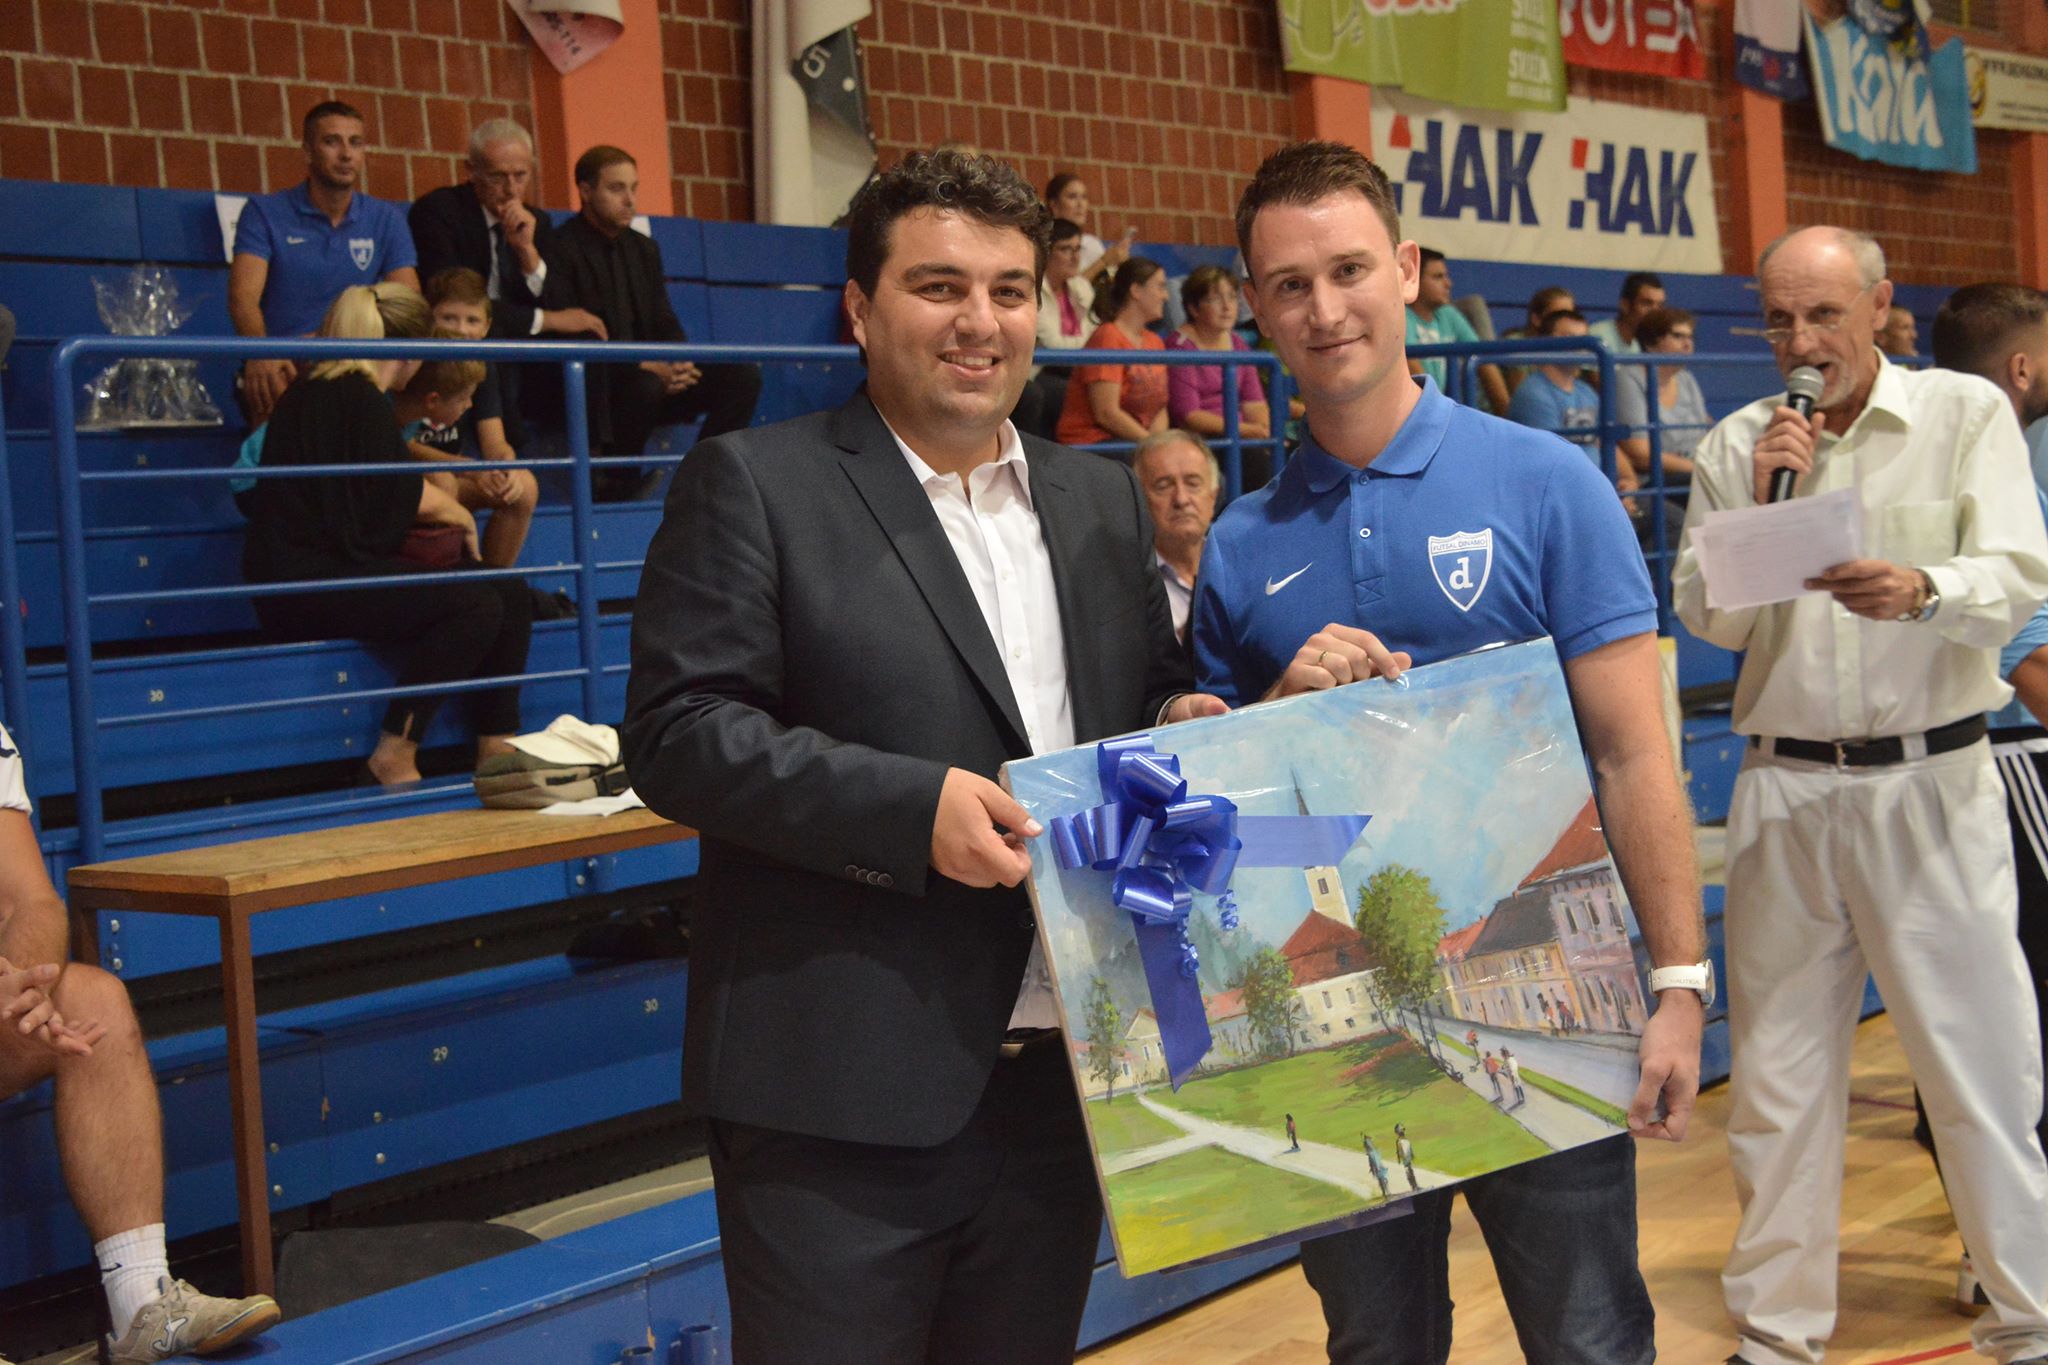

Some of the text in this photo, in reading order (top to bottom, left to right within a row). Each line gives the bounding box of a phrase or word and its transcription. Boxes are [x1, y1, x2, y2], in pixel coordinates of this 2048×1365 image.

[1391, 116, 1544, 227] HAK
[1567, 137, 1697, 237] HAK
[1433, 539, 1485, 551] FUTSAL DINAMO
[1449, 557, 1473, 590] d
[432, 1046, 449, 1062] 29
